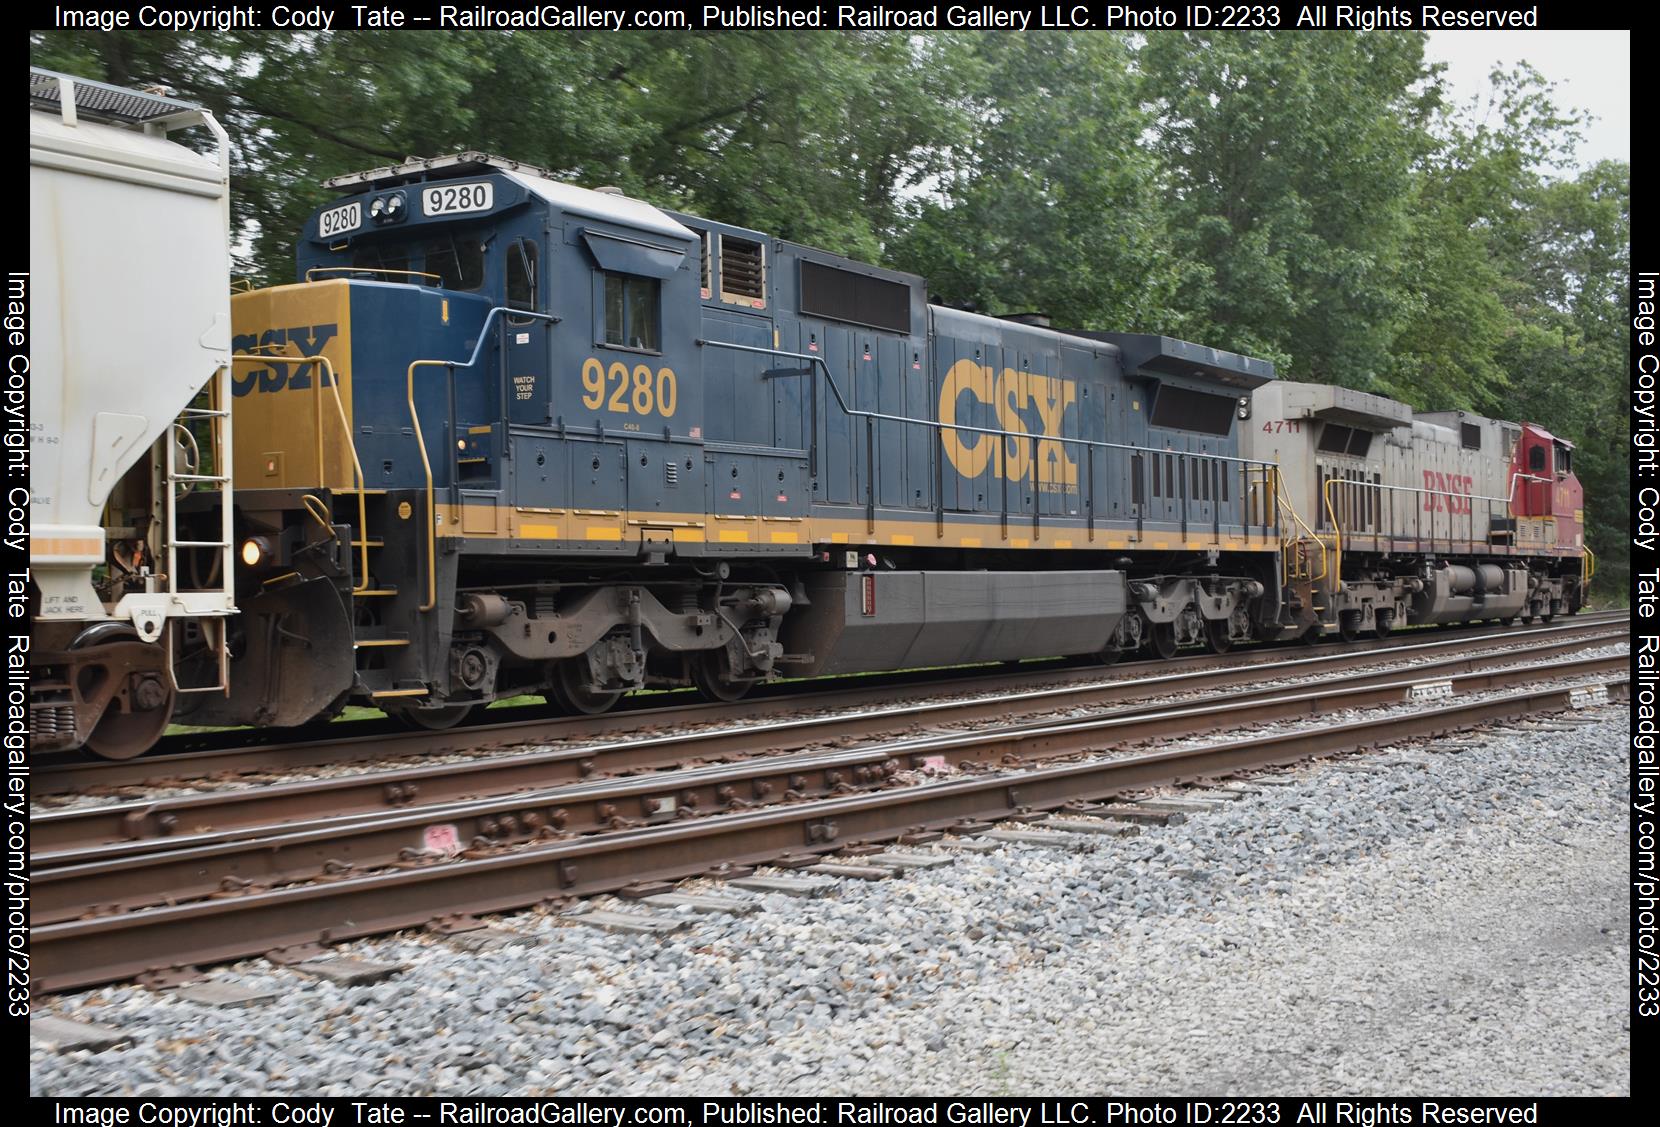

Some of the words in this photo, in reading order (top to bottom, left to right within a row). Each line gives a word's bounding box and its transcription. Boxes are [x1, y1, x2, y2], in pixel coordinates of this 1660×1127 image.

[430, 185, 486, 212] 9280
[324, 205, 357, 234] 9280
[232, 323, 339, 398] CSX
[513, 376, 535, 385] WATCH
[516, 384, 533, 392] YOUR
[582, 358, 677, 418] 9280
[516, 392, 533, 400] STEP
[939, 358, 1078, 485] CSX
[1263, 419, 1301, 434] 4711
[1423, 469, 1473, 515] BNSF
[64, 595, 78, 603] AND
[141, 609, 157, 617] PULL
